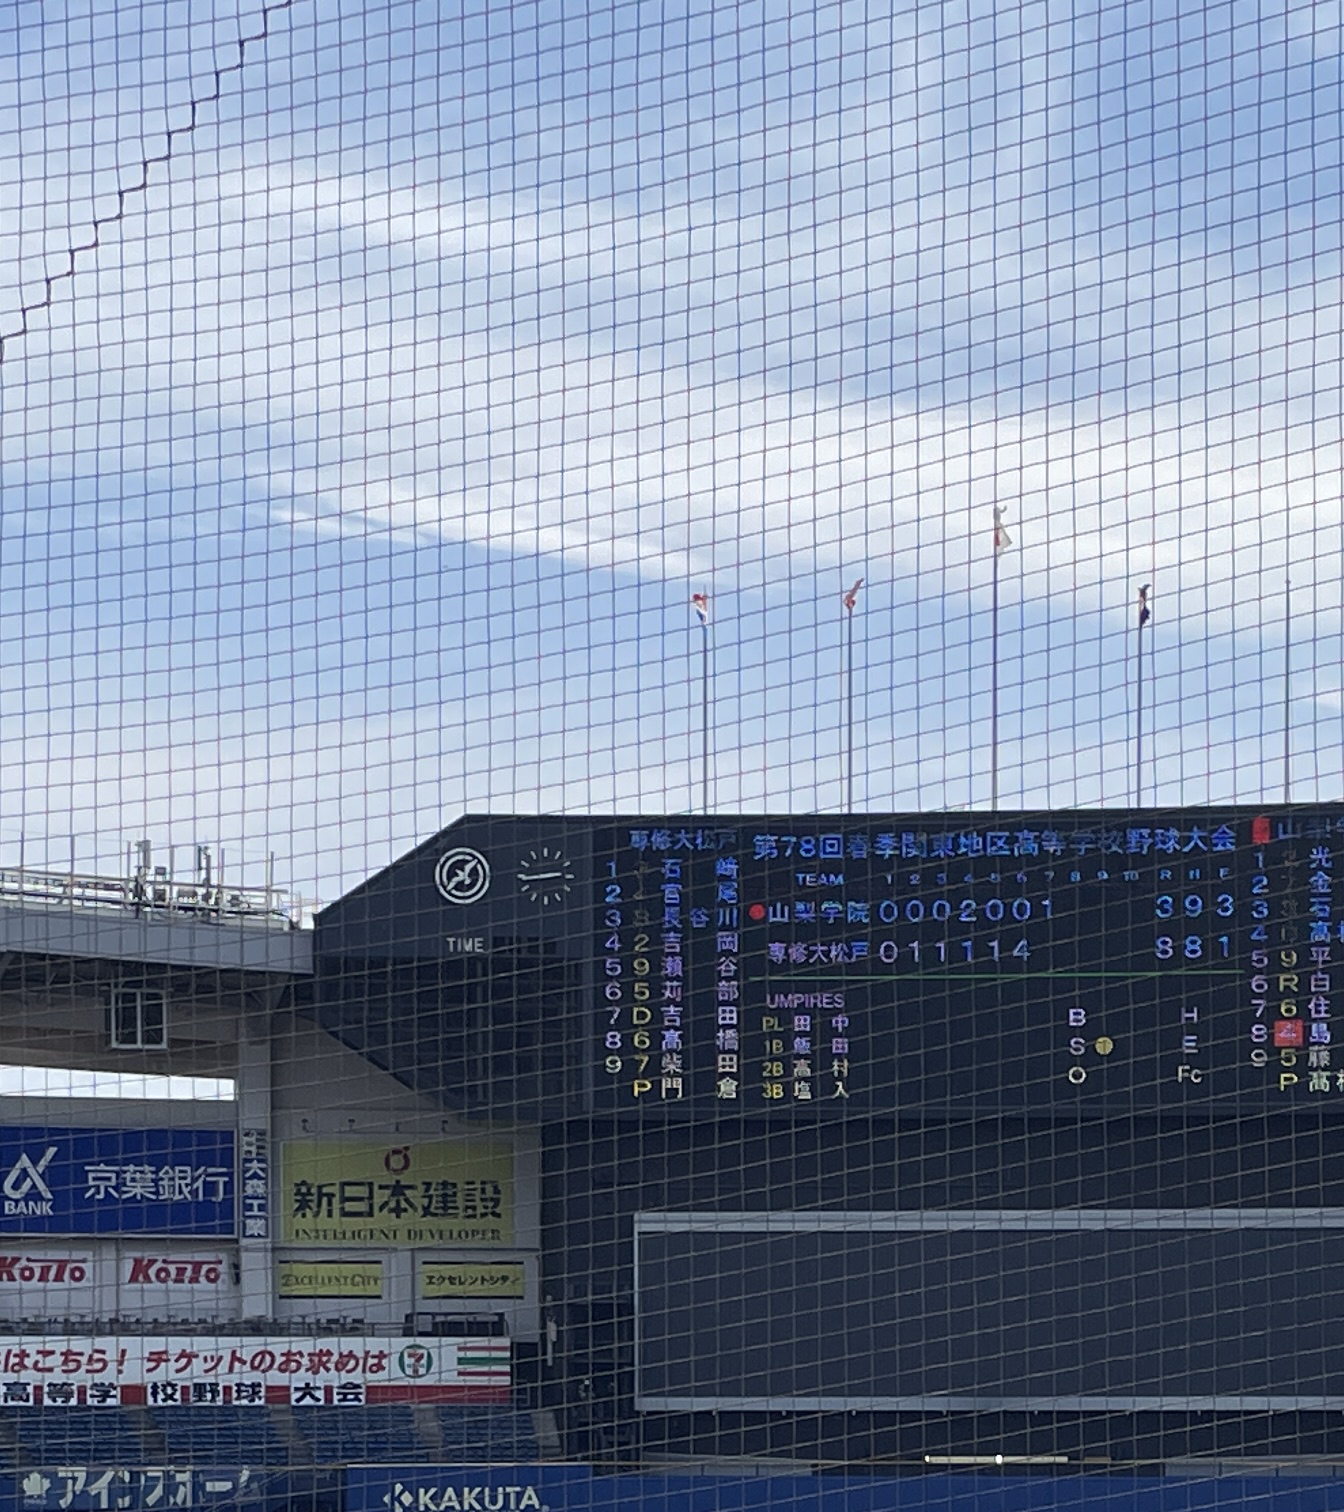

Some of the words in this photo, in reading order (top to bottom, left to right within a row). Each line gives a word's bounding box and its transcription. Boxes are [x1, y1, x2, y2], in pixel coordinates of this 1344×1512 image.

[608, 859, 618, 878] 1
[1254, 852, 1264, 868] 1
[796, 873, 844, 885] TEAM
[1251, 875, 1268, 894] 2
[606, 884, 622, 903] 2
[606, 909, 622, 928] 3
[661, 906, 739, 929] 長谷川
[768, 901, 870, 924] 山梨学院
[879, 900, 897, 922] 0
[906, 900, 924, 922] 0
[932, 899, 951, 921] 0
[959, 900, 977, 921] 2
[985, 898, 1004, 921] 0
[1012, 898, 1031, 920] 0
[1042, 898, 1054, 919] 1
[1156, 895, 1173, 918] 3
[1185, 894, 1203, 917] 9
[1216, 894, 1234, 916] 3
[1251, 900, 1268, 919] 3
[606, 934, 621, 951] 4
[633, 934, 650, 952] 2
[661, 931, 739, 953] 吉岡
[1250, 925, 1268, 942] 4
[446, 937, 484, 952] TIME
[768, 941, 869, 964] 専修大松戸
[879, 940, 898, 963] 0
[908, 940, 920, 962] 1
[1013, 938, 1031, 961] 4
[1184, 936, 1202, 959] 8
[1218, 936, 1228, 957] 1
[606, 958, 622, 976] 5
[633, 958, 650, 976] 9
[1251, 950, 1268, 968] 5
[1280, 950, 1297, 968] 9
[605, 983, 623, 1001] 6
[633, 982, 650, 1000] 5
[1250, 974, 1268, 993] 6
[1279, 974, 1299, 992] R
[766, 992, 845, 1009] UMPIRES
[1251, 1000, 1267, 1018] 7
[1280, 999, 1297, 1018] 6
[606, 1008, 621, 1025] 7
[632, 1007, 651, 1025] D
[661, 1005, 739, 1026] 吉田
[762, 1016, 784, 1031] PL
[793, 1014, 849, 1033] 田中
[1068, 1008, 1086, 1027] B
[1182, 1007, 1198, 1024] H
[605, 1031, 623, 1049] 8
[633, 1031, 651, 1049] 6
[1251, 1024, 1268, 1043] 8
[764, 1039, 784, 1055] 1B
[1068, 1037, 1086, 1056] S
[1182, 1035, 1198, 1053] E
[605, 1055, 622, 1074] 9
[633, 1055, 650, 1073] 7
[1251, 1049, 1268, 1067] 9
[1280, 1048, 1297, 1067] 5
[762, 1062, 784, 1077] 2B
[1068, 1066, 1087, 1085] O
[1178, 1066, 1203, 1083] Fc
[633, 1079, 652, 1098] P
[762, 1083, 784, 1098] 3B
[1279, 1072, 1299, 1091] P
[84, 1163, 230, 1202] 京葉銀行
[4, 1200, 54, 1216] BANK
[292, 1179, 502, 1220] 新日本建設
[294, 1227, 399, 1241] INTELLIGENT
[407, 1227, 502, 1241] DEVELOPER
[424, 1272, 520, 1288] エクセレントシティ
[146, 1349, 389, 1376] チケットのお求めは
[418, 1486, 541, 1511] KAKUTA
